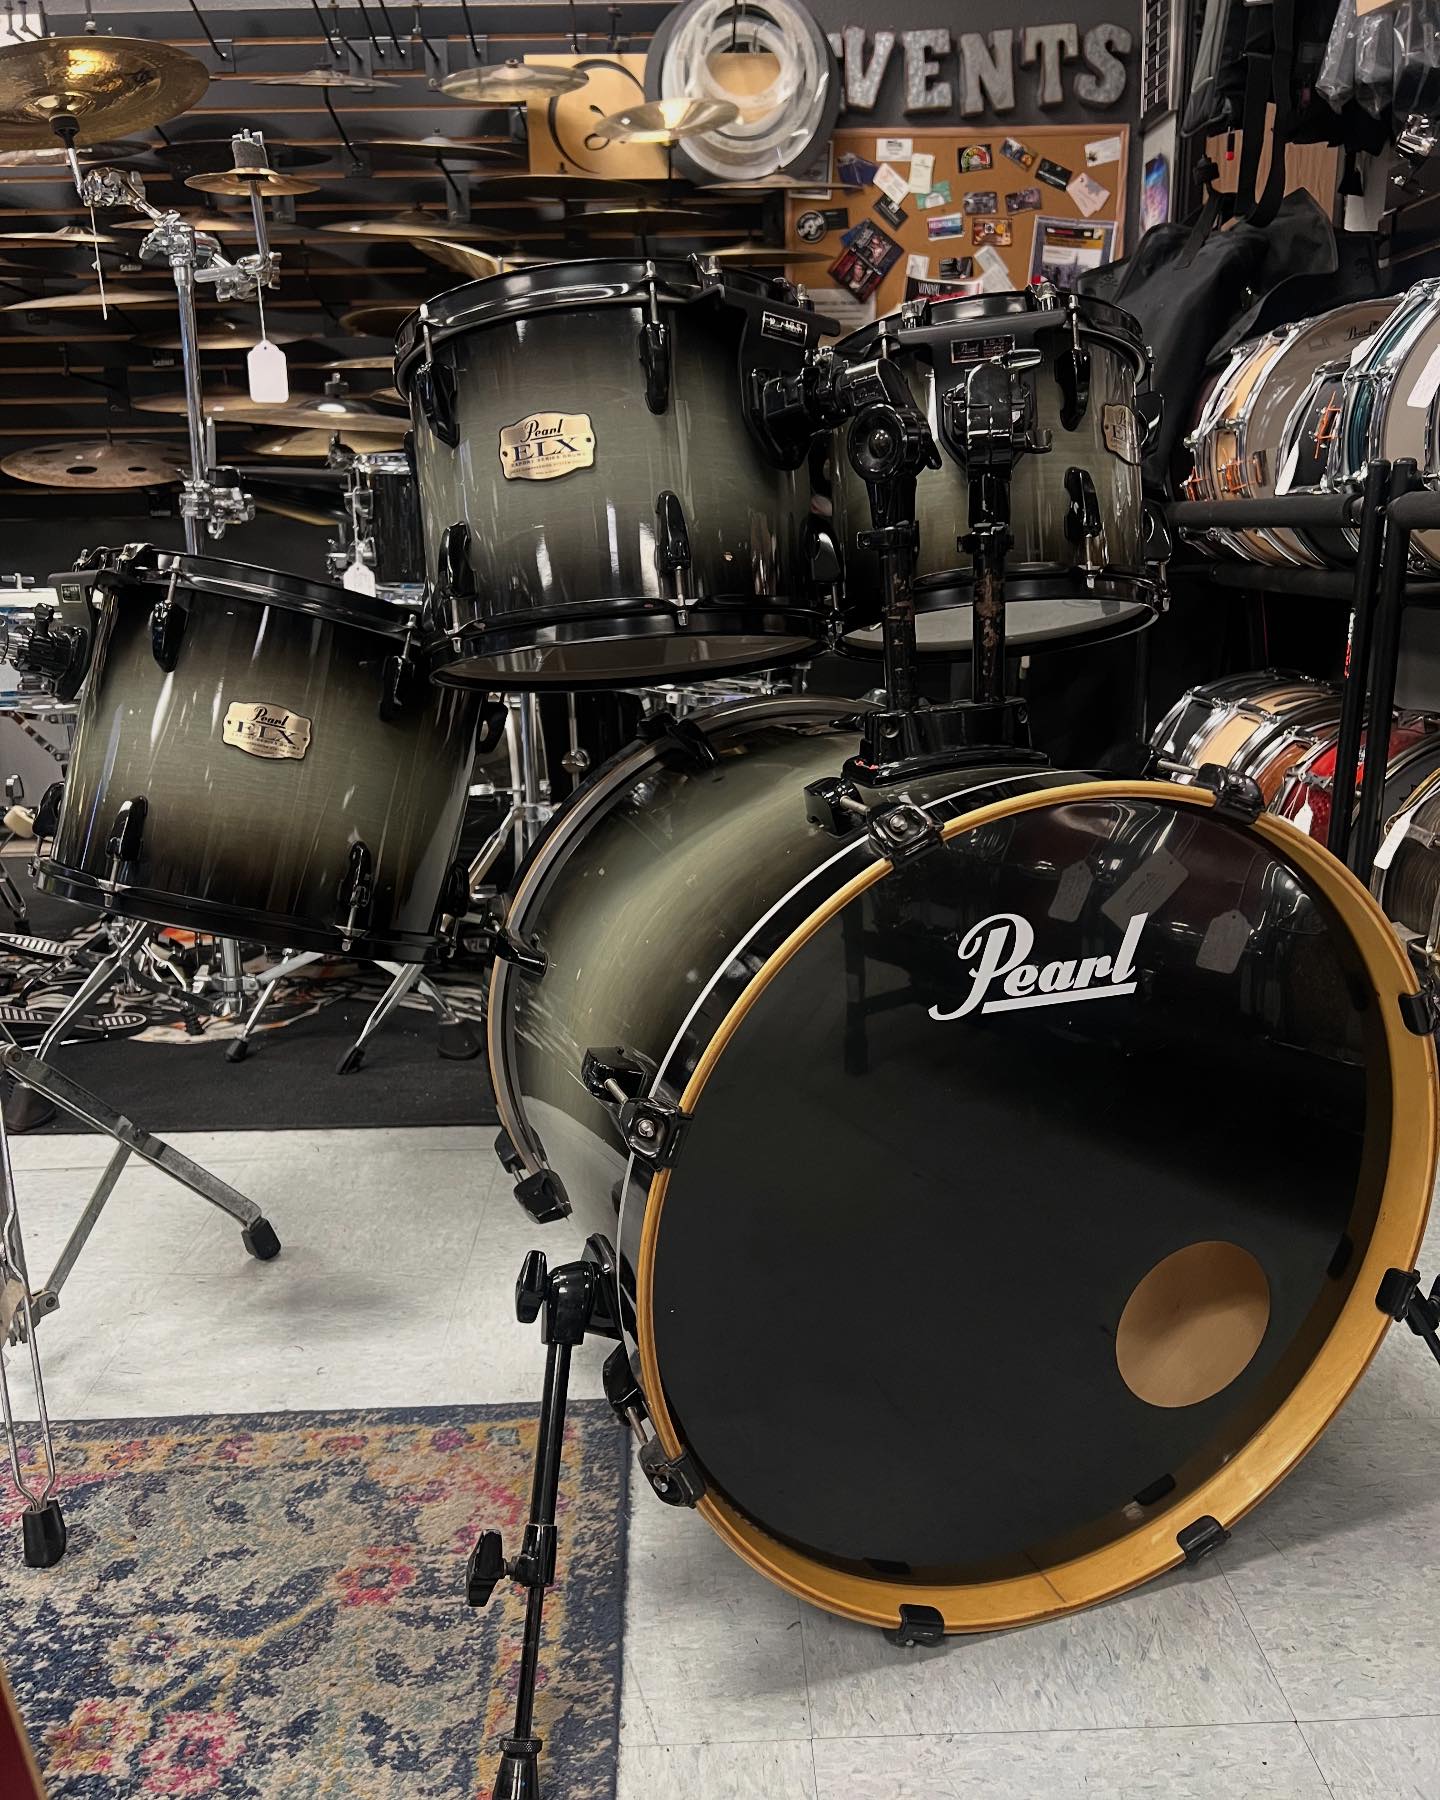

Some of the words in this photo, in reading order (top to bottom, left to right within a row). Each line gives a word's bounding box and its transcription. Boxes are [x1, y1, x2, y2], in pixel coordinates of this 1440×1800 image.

[827, 22, 1132, 117] VENTS
[520, 418, 564, 443] Pearl
[513, 437, 580, 461] ELX
[252, 706, 289, 729] Pearl
[927, 912, 1149, 1021] Pearl
